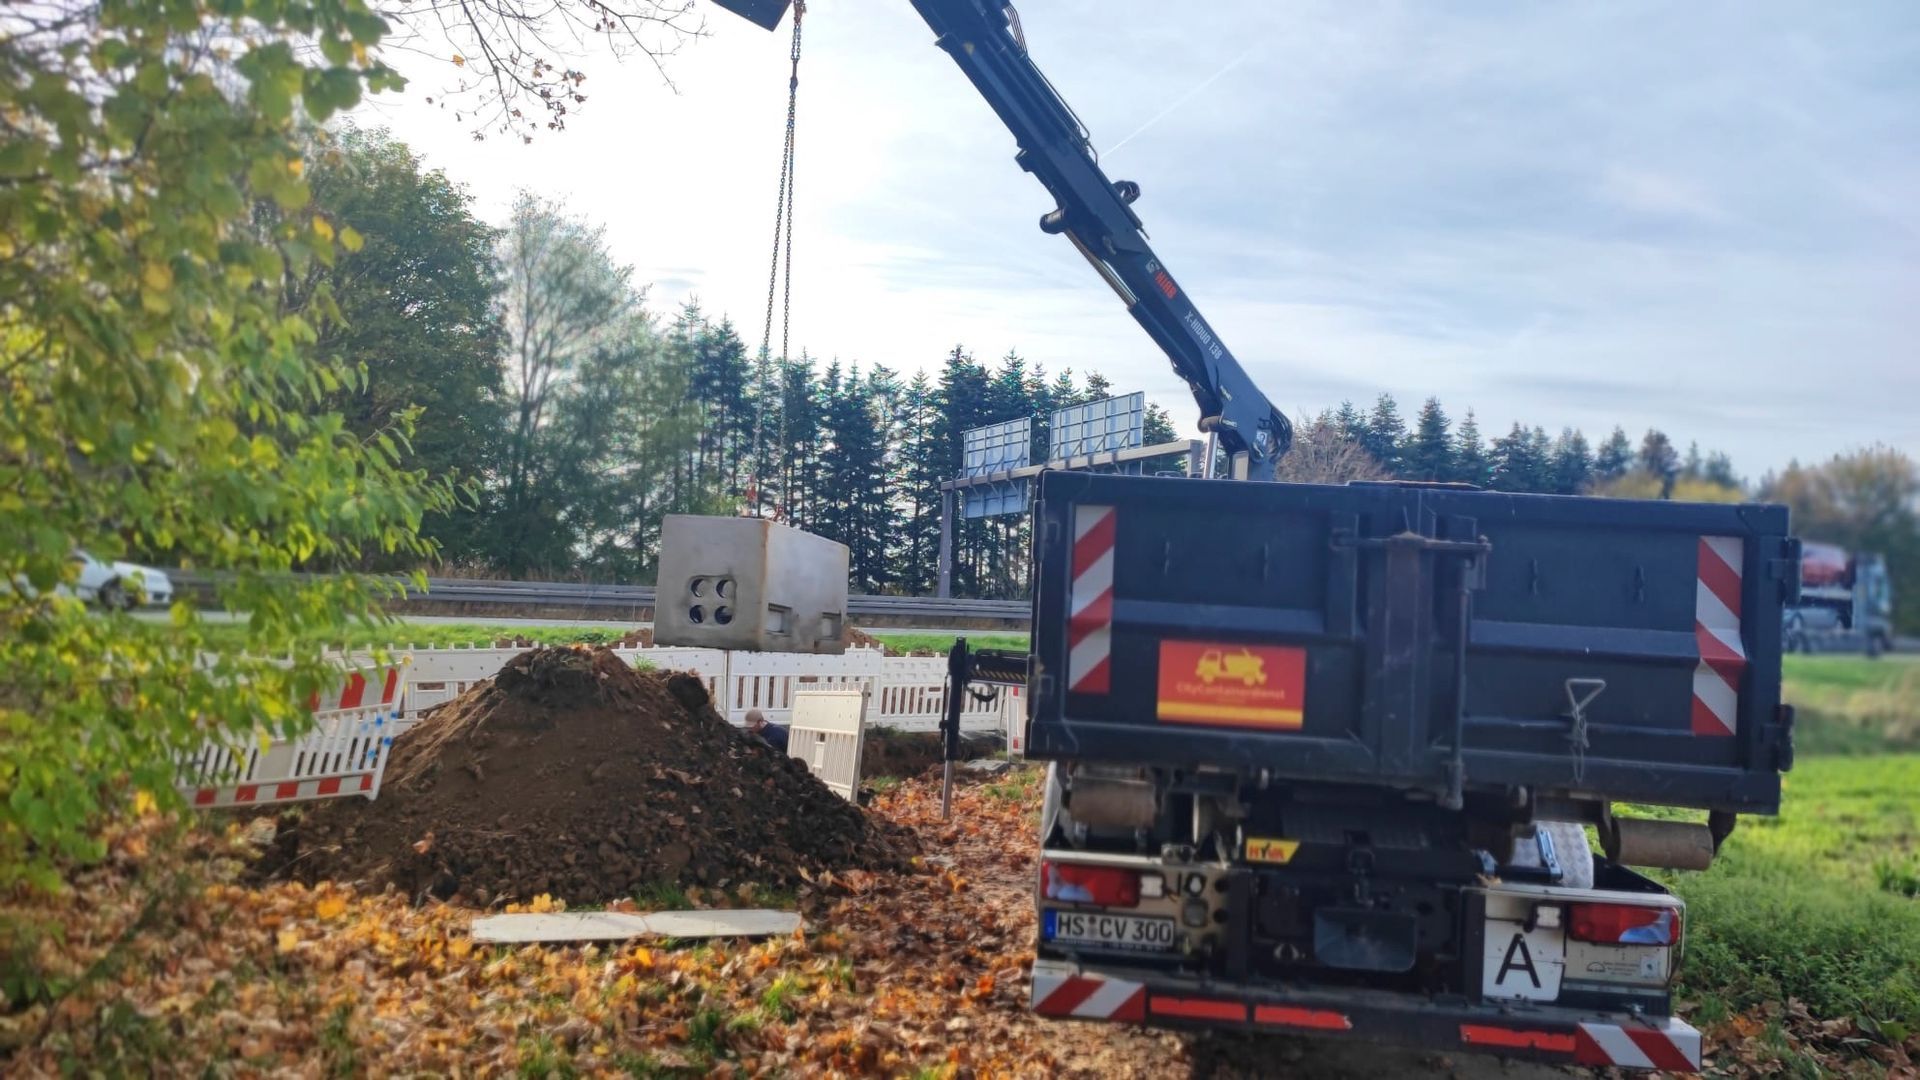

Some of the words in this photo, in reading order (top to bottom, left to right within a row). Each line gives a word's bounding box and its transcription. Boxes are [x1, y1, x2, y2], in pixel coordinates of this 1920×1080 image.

[1057, 915, 1085, 937] HS
[1100, 917, 1128, 940] CV
[1132, 920, 1172, 944] 300
[1495, 933, 1541, 989] A
